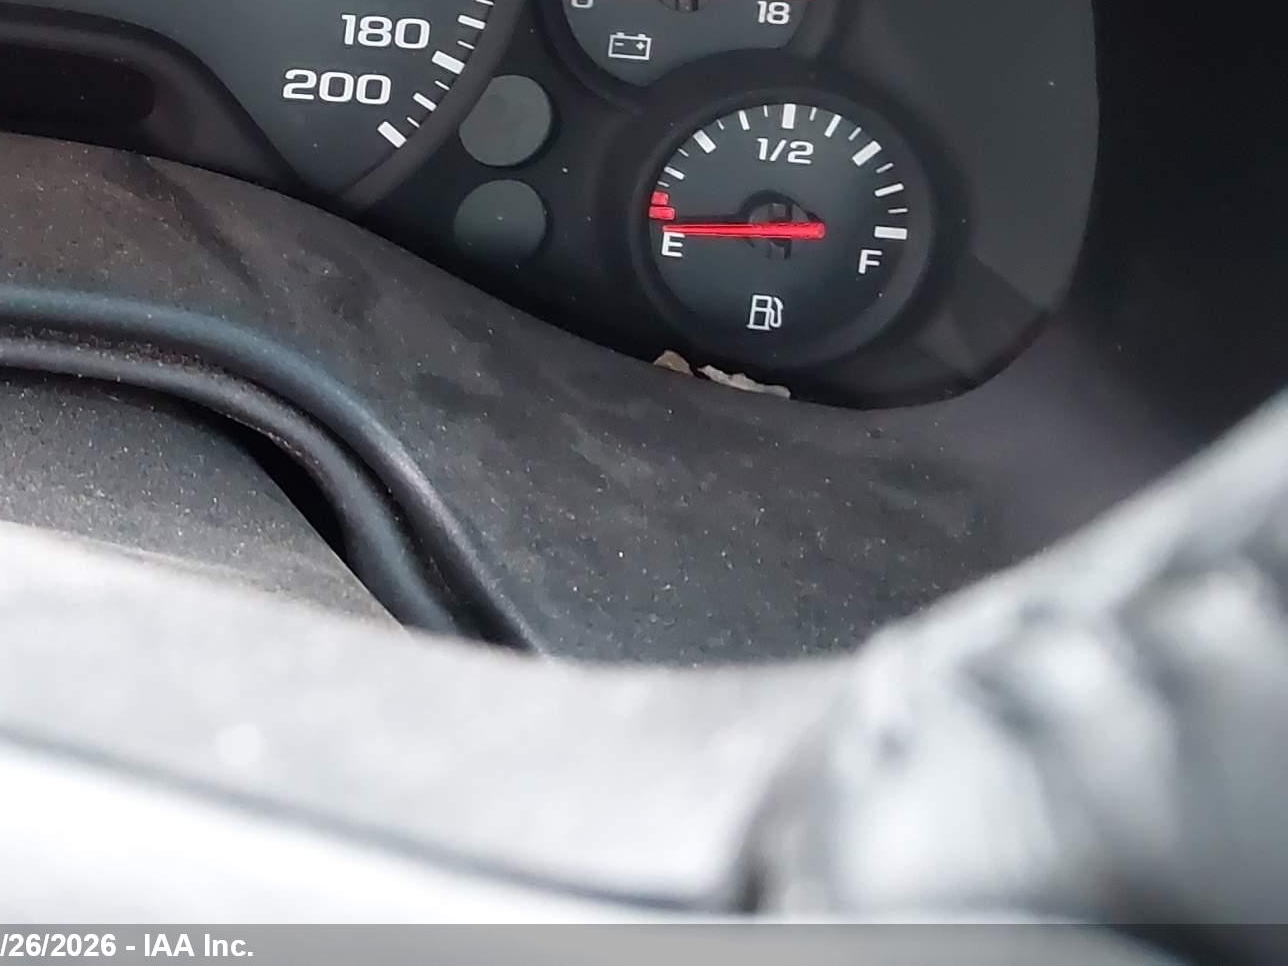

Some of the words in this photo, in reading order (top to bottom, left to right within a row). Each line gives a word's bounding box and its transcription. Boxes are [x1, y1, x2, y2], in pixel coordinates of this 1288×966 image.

[757, 0, 790, 25] 18
[341, 14, 430, 49] 180
[282, 69, 392, 105] 200
[757, 137, 814, 164] 1/2
[661, 233, 685, 258] E
[858, 249, 882, 274] F
